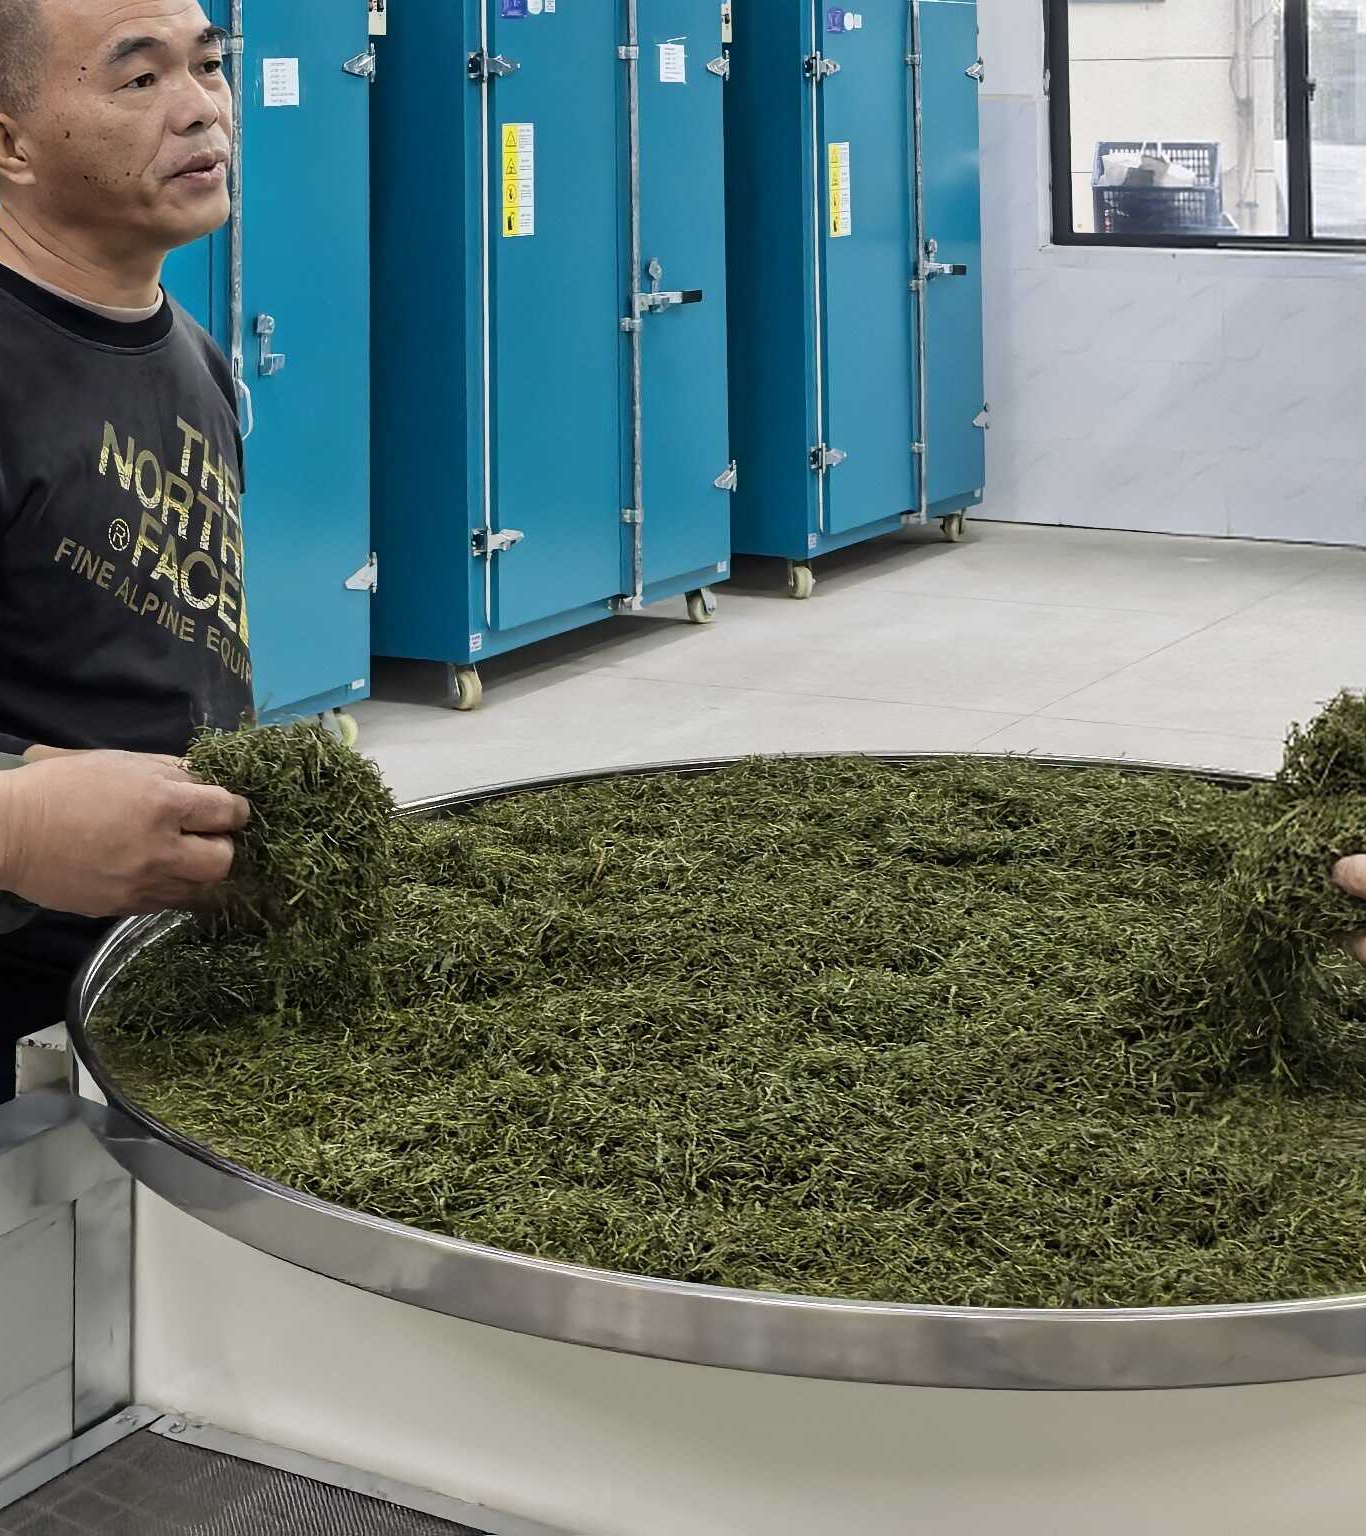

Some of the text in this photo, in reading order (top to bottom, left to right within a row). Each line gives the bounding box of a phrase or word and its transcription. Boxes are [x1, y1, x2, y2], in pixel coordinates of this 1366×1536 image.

[98, 420, 242, 580] NORTH
[176, 415, 240, 524] THE
[53, 537, 115, 589] FINE
[115, 576, 196, 644] ALPINE
[131, 511, 241, 633] FACE
